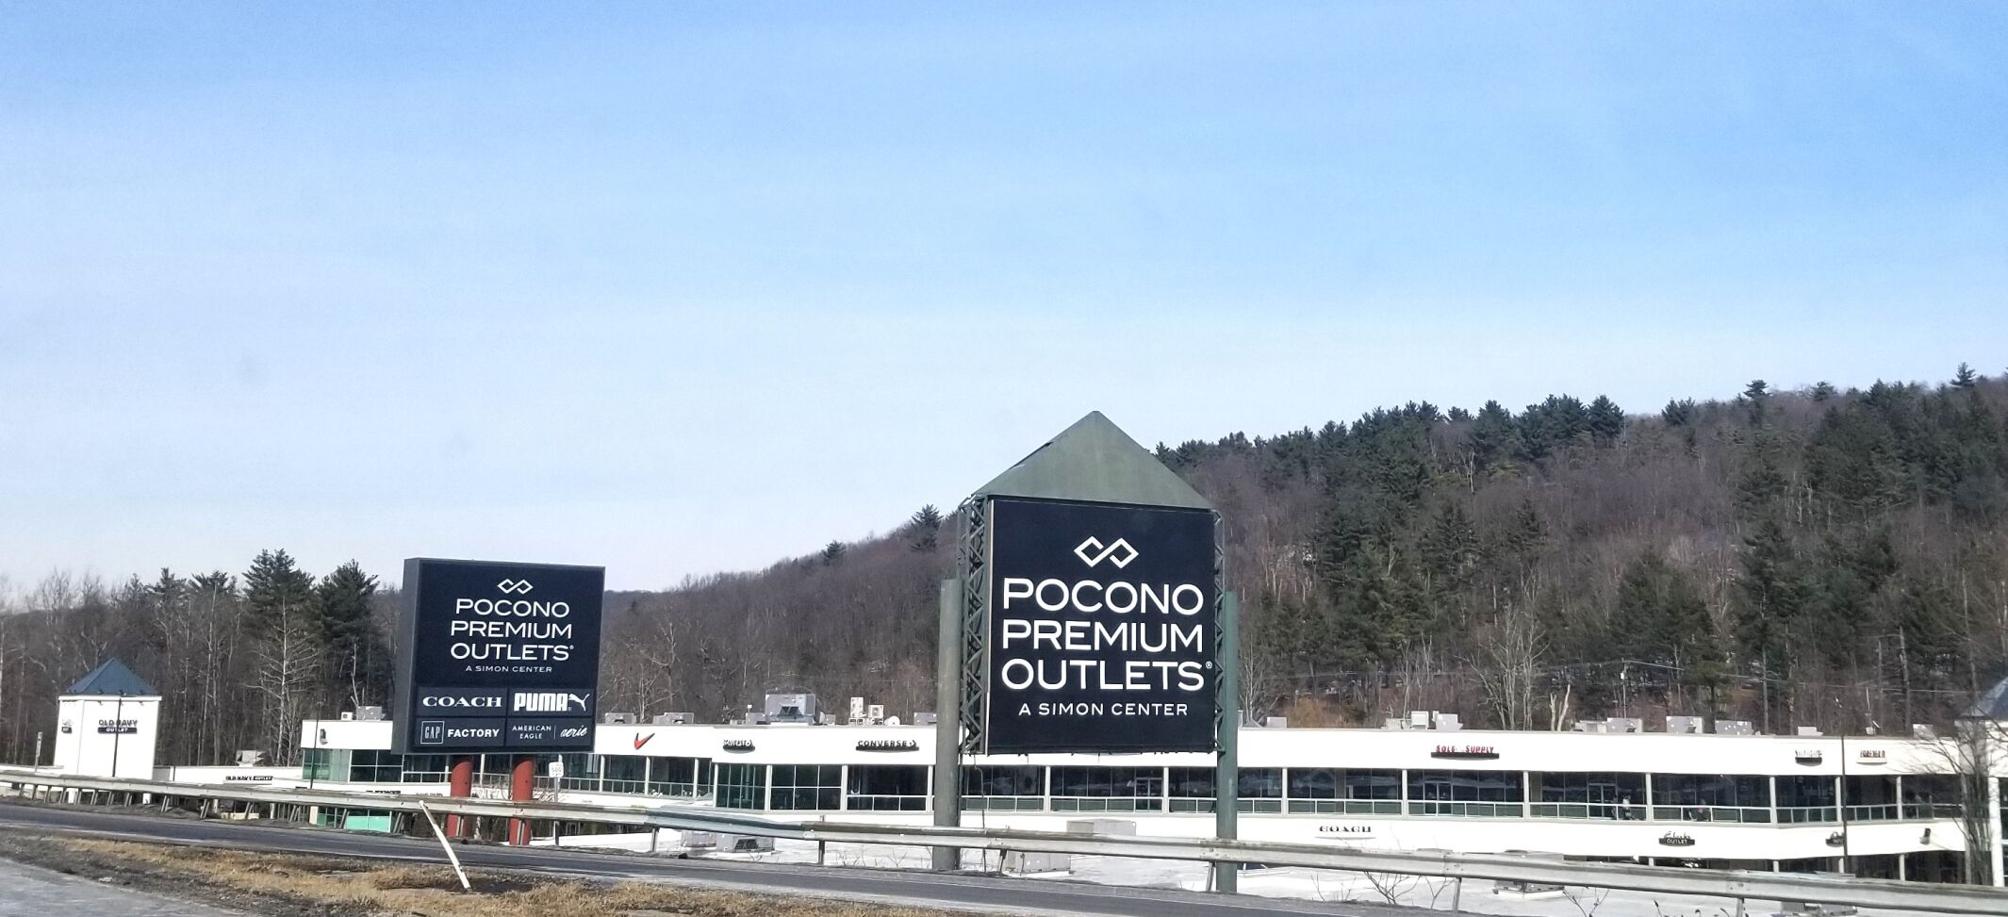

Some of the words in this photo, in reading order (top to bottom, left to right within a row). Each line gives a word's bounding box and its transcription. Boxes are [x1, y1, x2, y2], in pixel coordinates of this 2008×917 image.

[1003, 577, 1204, 616] POCONO
[455, 598, 570, 618] POCONO
[450, 620, 572, 639] PREMIUM
[1002, 618, 1203, 653] PREMIUM
[512, 665, 553, 673] CENTER
[422, 696, 503, 708] COACH
[513, 692, 567, 712] PUMA
[1018, 703, 1031, 716] A
[1038, 703, 1104, 716] SIMON
[1111, 703, 1188, 716] CENTER
[424, 726, 440, 739] GAP
[447, 728, 500, 738] FACTORY
[560, 725, 588, 737] aerie
